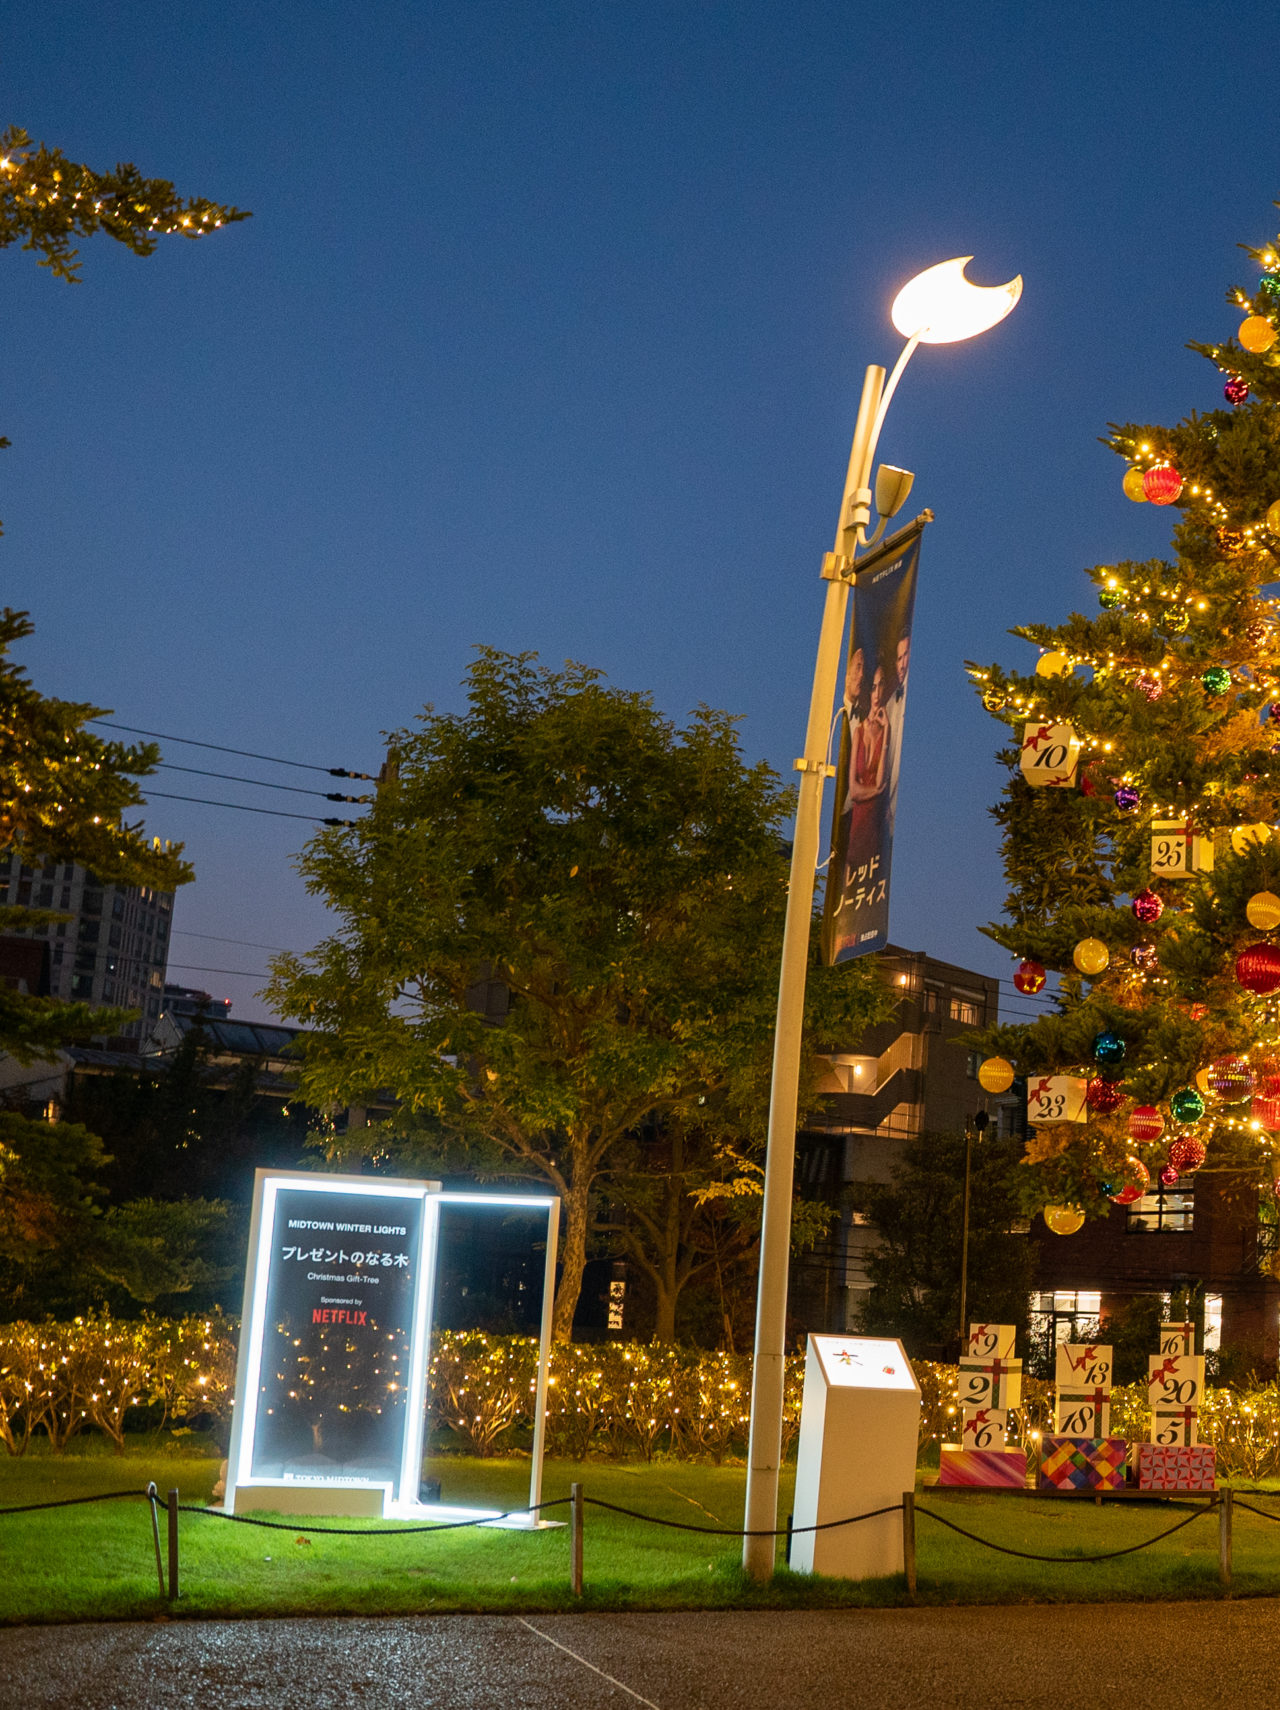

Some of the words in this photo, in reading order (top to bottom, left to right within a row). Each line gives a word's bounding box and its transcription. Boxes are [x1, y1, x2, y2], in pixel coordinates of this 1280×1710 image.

[1033, 744, 1067, 768] 10
[1152, 841, 1184, 867] 25
[845, 855, 880, 887] レッド
[833, 879, 886, 917] ノーティス
[1034, 1095, 1066, 1119] 23
[288, 1219, 334, 1230] MIDTOWN
[336, 1222, 372, 1233] WINTER
[373, 1225, 406, 1236] LIGHTS
[282, 1246, 409, 1268] プレゼントのなる木
[307, 1272, 345, 1282] Christmas
[346, 1275, 380, 1285] Gift-Tree
[320, 1296, 354, 1305] Sponsored
[312, 1308, 368, 1326] NETFLIX
[973, 1333, 999, 1356] 9
[1161, 1335, 1185, 1355] 16
[1084, 1362, 1110, 1386] 13
[959, 1376, 990, 1404] 2
[1156, 1378, 1197, 1404] 20
[1061, 1406, 1094, 1434] 18
[974, 1423, 1003, 1448] 6
[1156, 1421, 1183, 1445] 5
